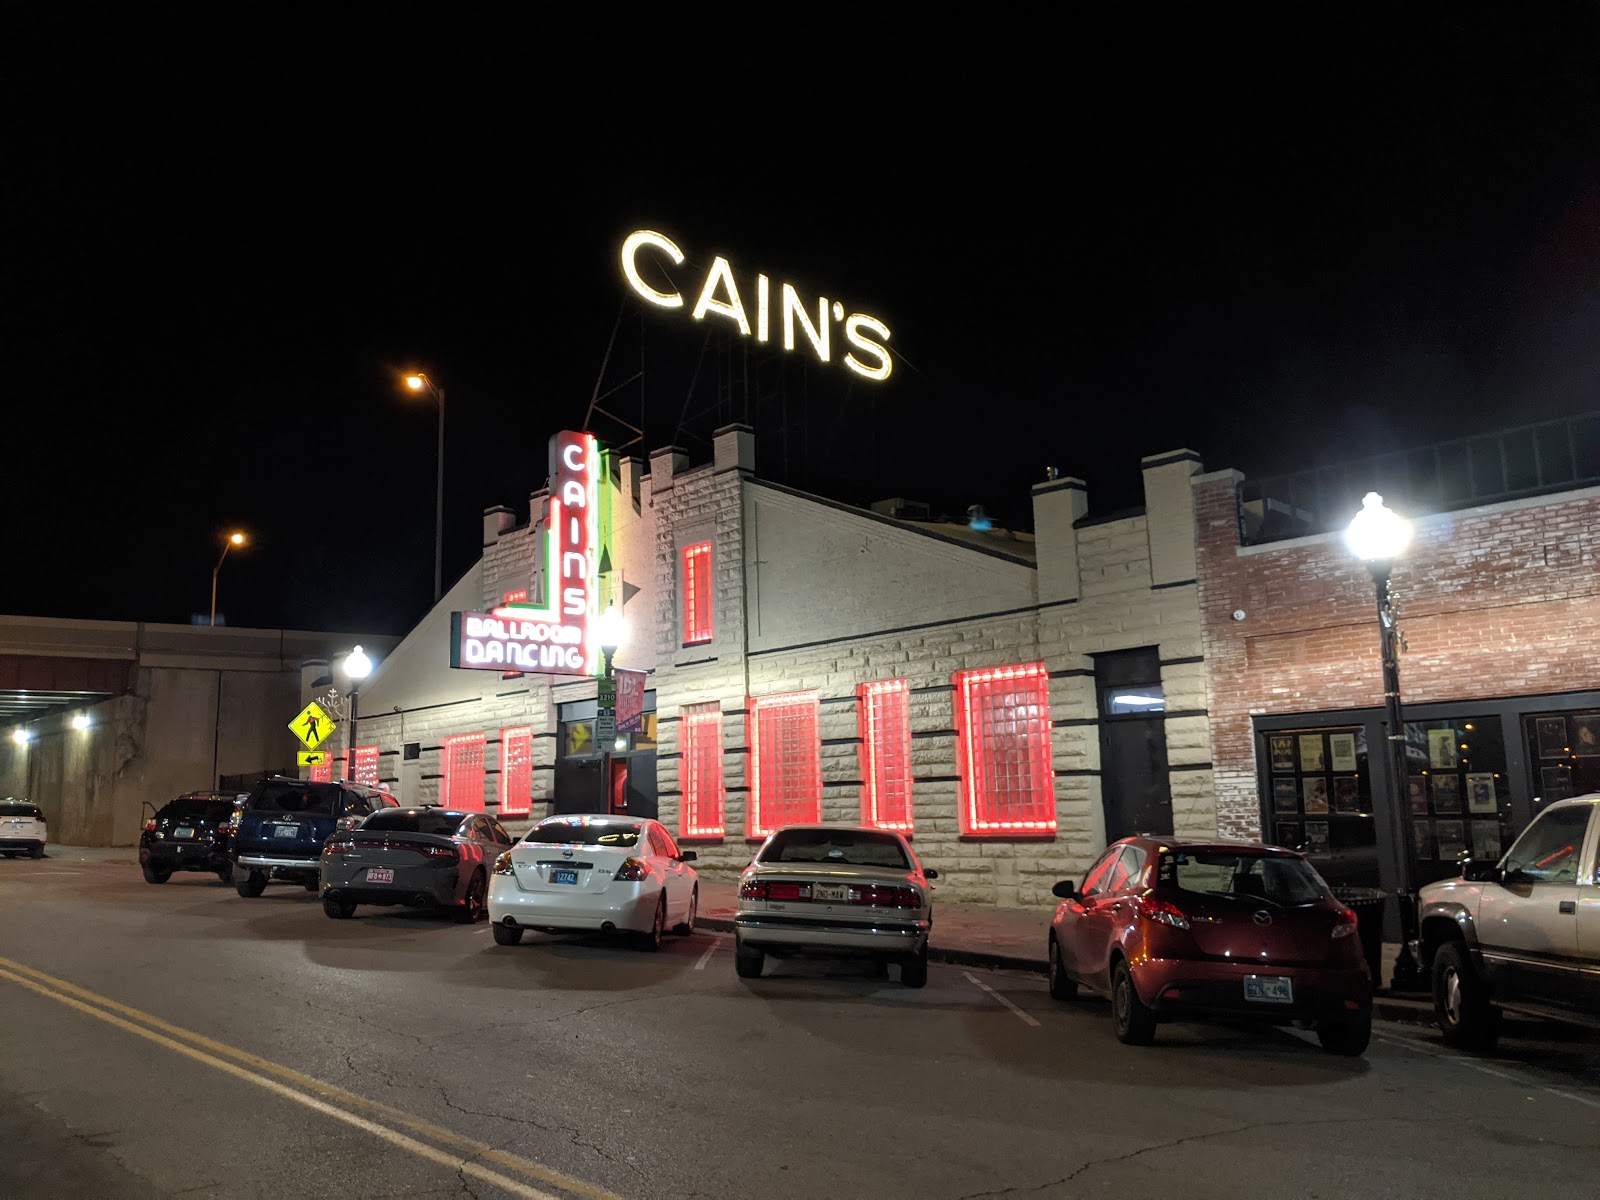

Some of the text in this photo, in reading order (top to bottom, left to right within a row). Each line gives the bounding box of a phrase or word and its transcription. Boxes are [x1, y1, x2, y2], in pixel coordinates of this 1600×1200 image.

[621, 229, 893, 381] CAIN'S
[563, 444, 587, 616] CAINS
[466, 617, 582, 646] BALLROOM
[465, 639, 584, 670] DANCING
[560, 873, 575, 882] 2742
